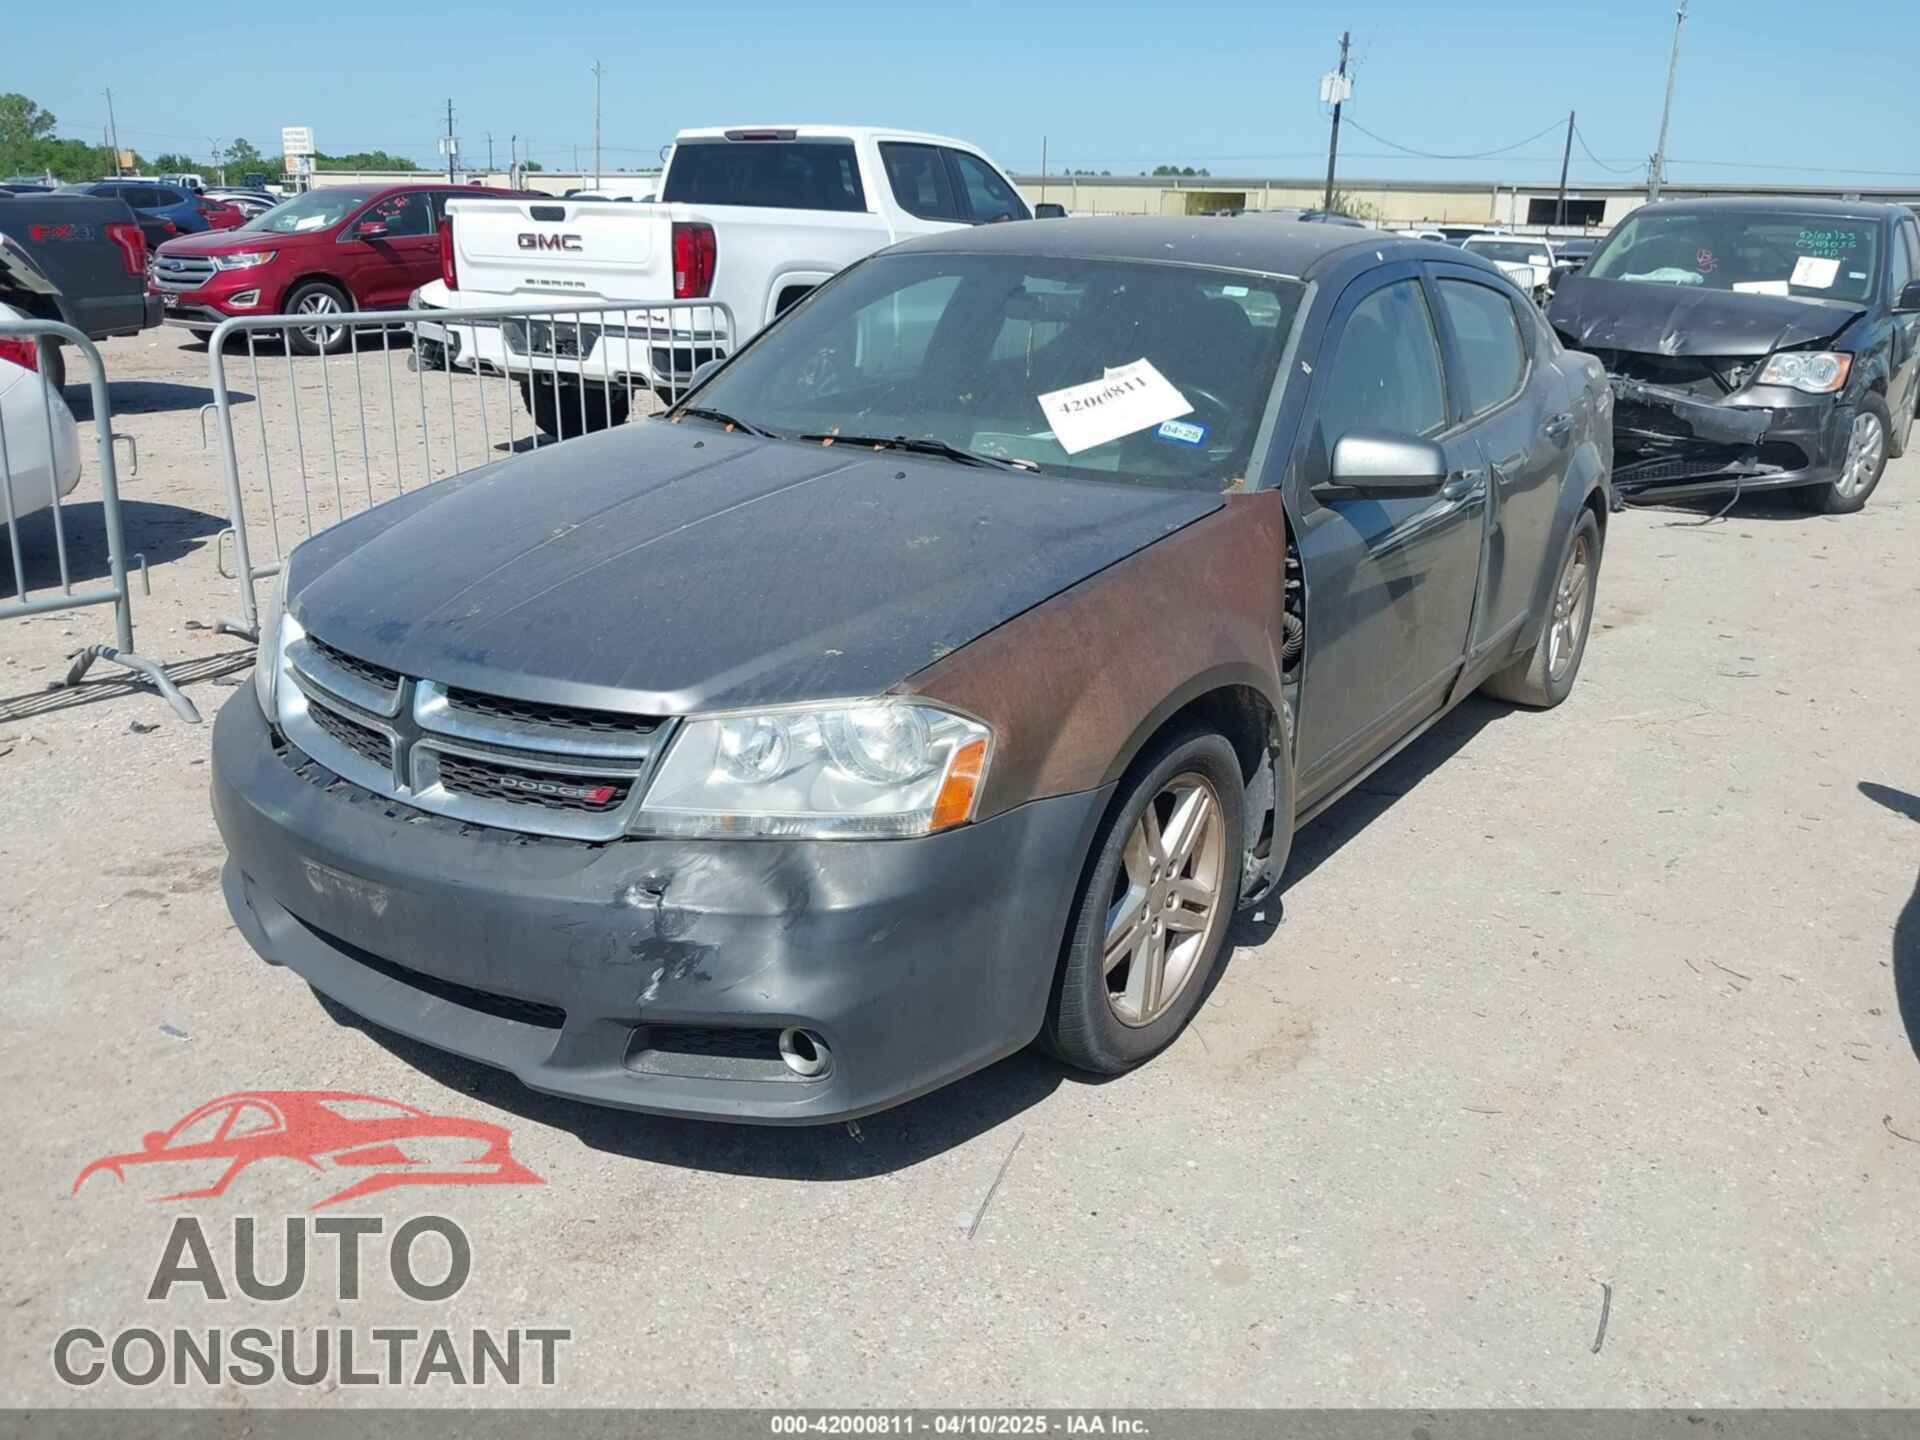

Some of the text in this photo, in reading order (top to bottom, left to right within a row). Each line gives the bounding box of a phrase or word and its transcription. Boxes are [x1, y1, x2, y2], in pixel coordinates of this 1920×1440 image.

[517, 232, 583, 251] GMC
[525, 278, 586, 288] SIERRA
[1162, 423, 1200, 441] 04-25
[500, 776, 597, 799] DODGE
